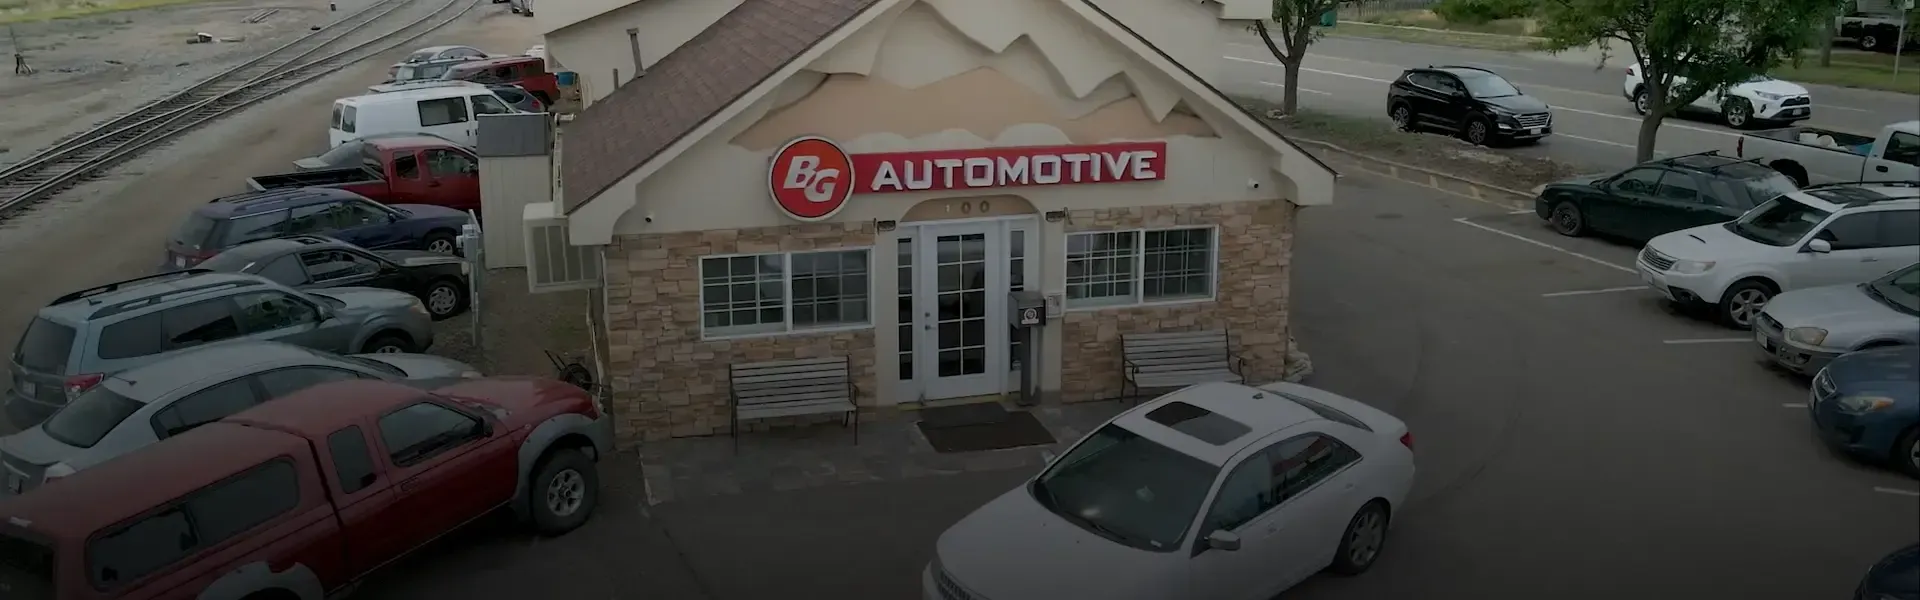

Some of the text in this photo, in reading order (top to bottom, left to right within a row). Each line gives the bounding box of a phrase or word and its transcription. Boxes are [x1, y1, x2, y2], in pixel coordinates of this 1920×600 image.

[783, 150, 1158, 203] BG AUTOMOTIVE
[944, 200, 990, 214] 100
